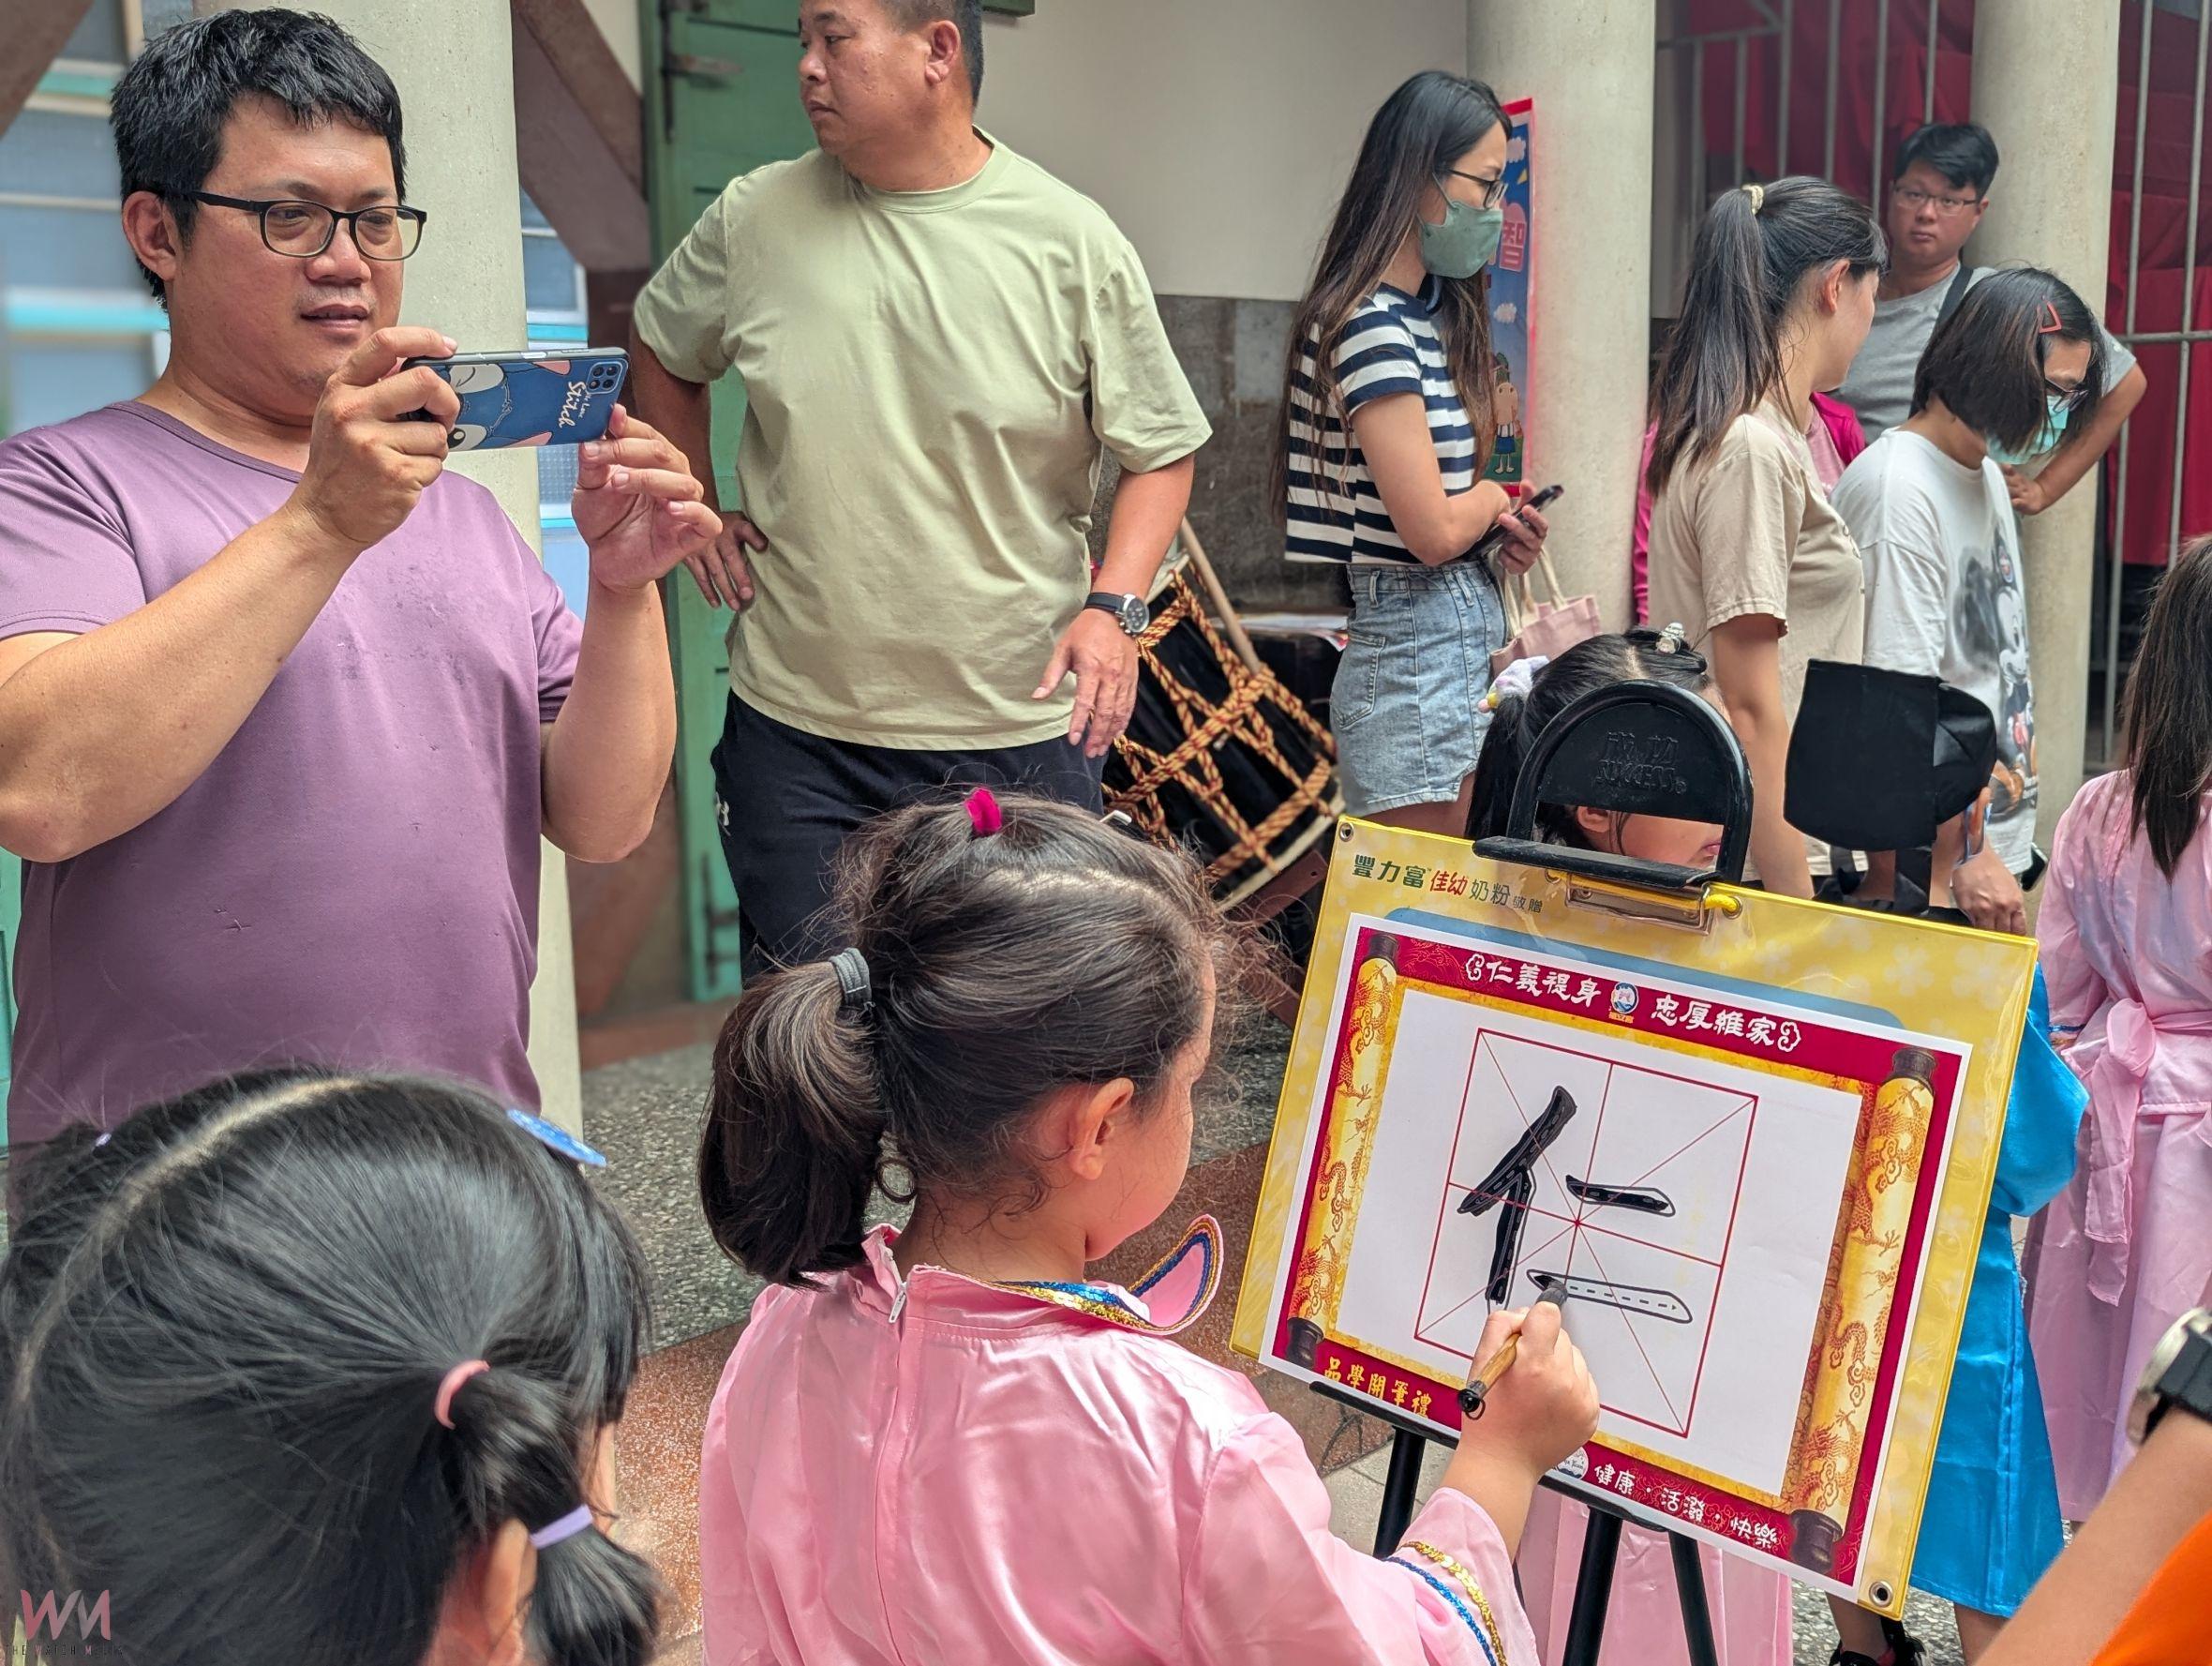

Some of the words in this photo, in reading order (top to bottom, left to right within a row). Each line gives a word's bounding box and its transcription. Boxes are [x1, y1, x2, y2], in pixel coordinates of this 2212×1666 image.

[559, 381, 586, 428] Stitch
[1323, 1356, 1433, 1418] 品學開筆禮
